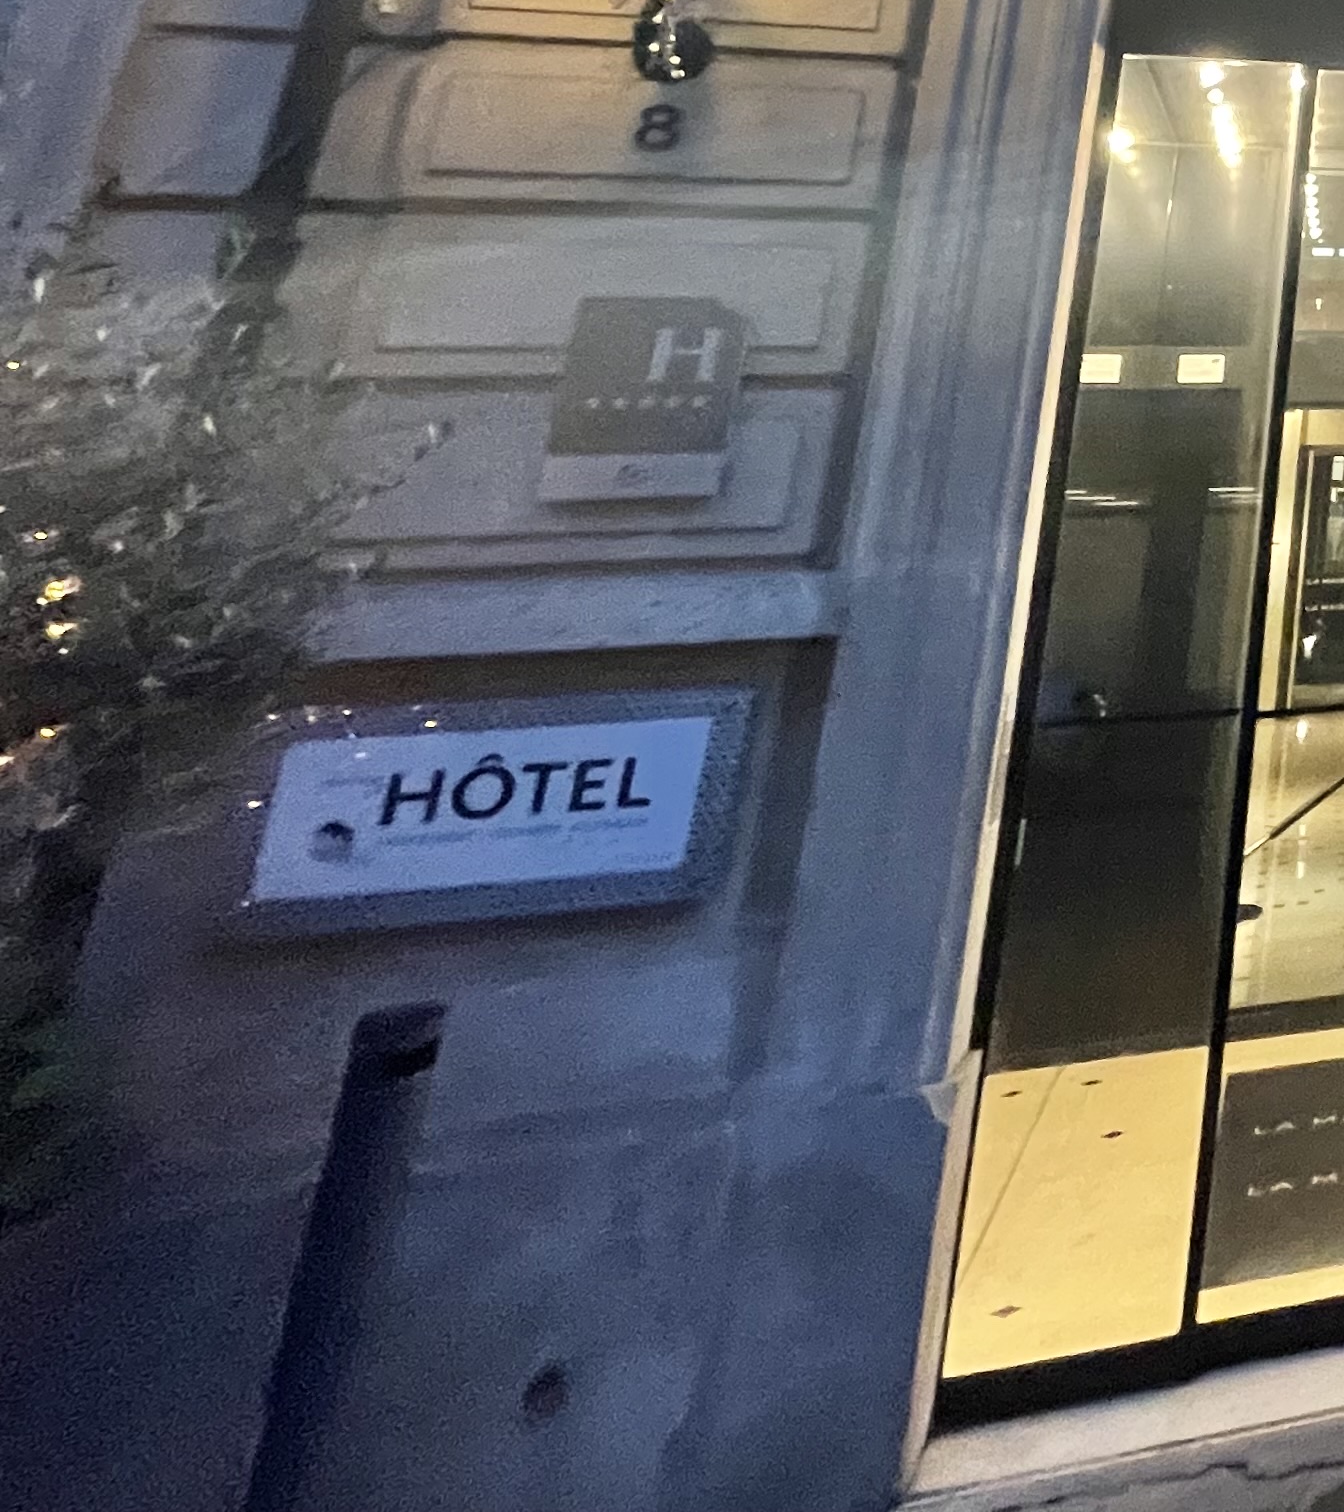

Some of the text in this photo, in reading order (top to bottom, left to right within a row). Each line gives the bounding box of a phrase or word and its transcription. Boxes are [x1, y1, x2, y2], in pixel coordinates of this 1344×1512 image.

[633, 103, 682, 152] 8
[646, 326, 728, 384] H
[378, 752, 652, 827] HÔTEL
